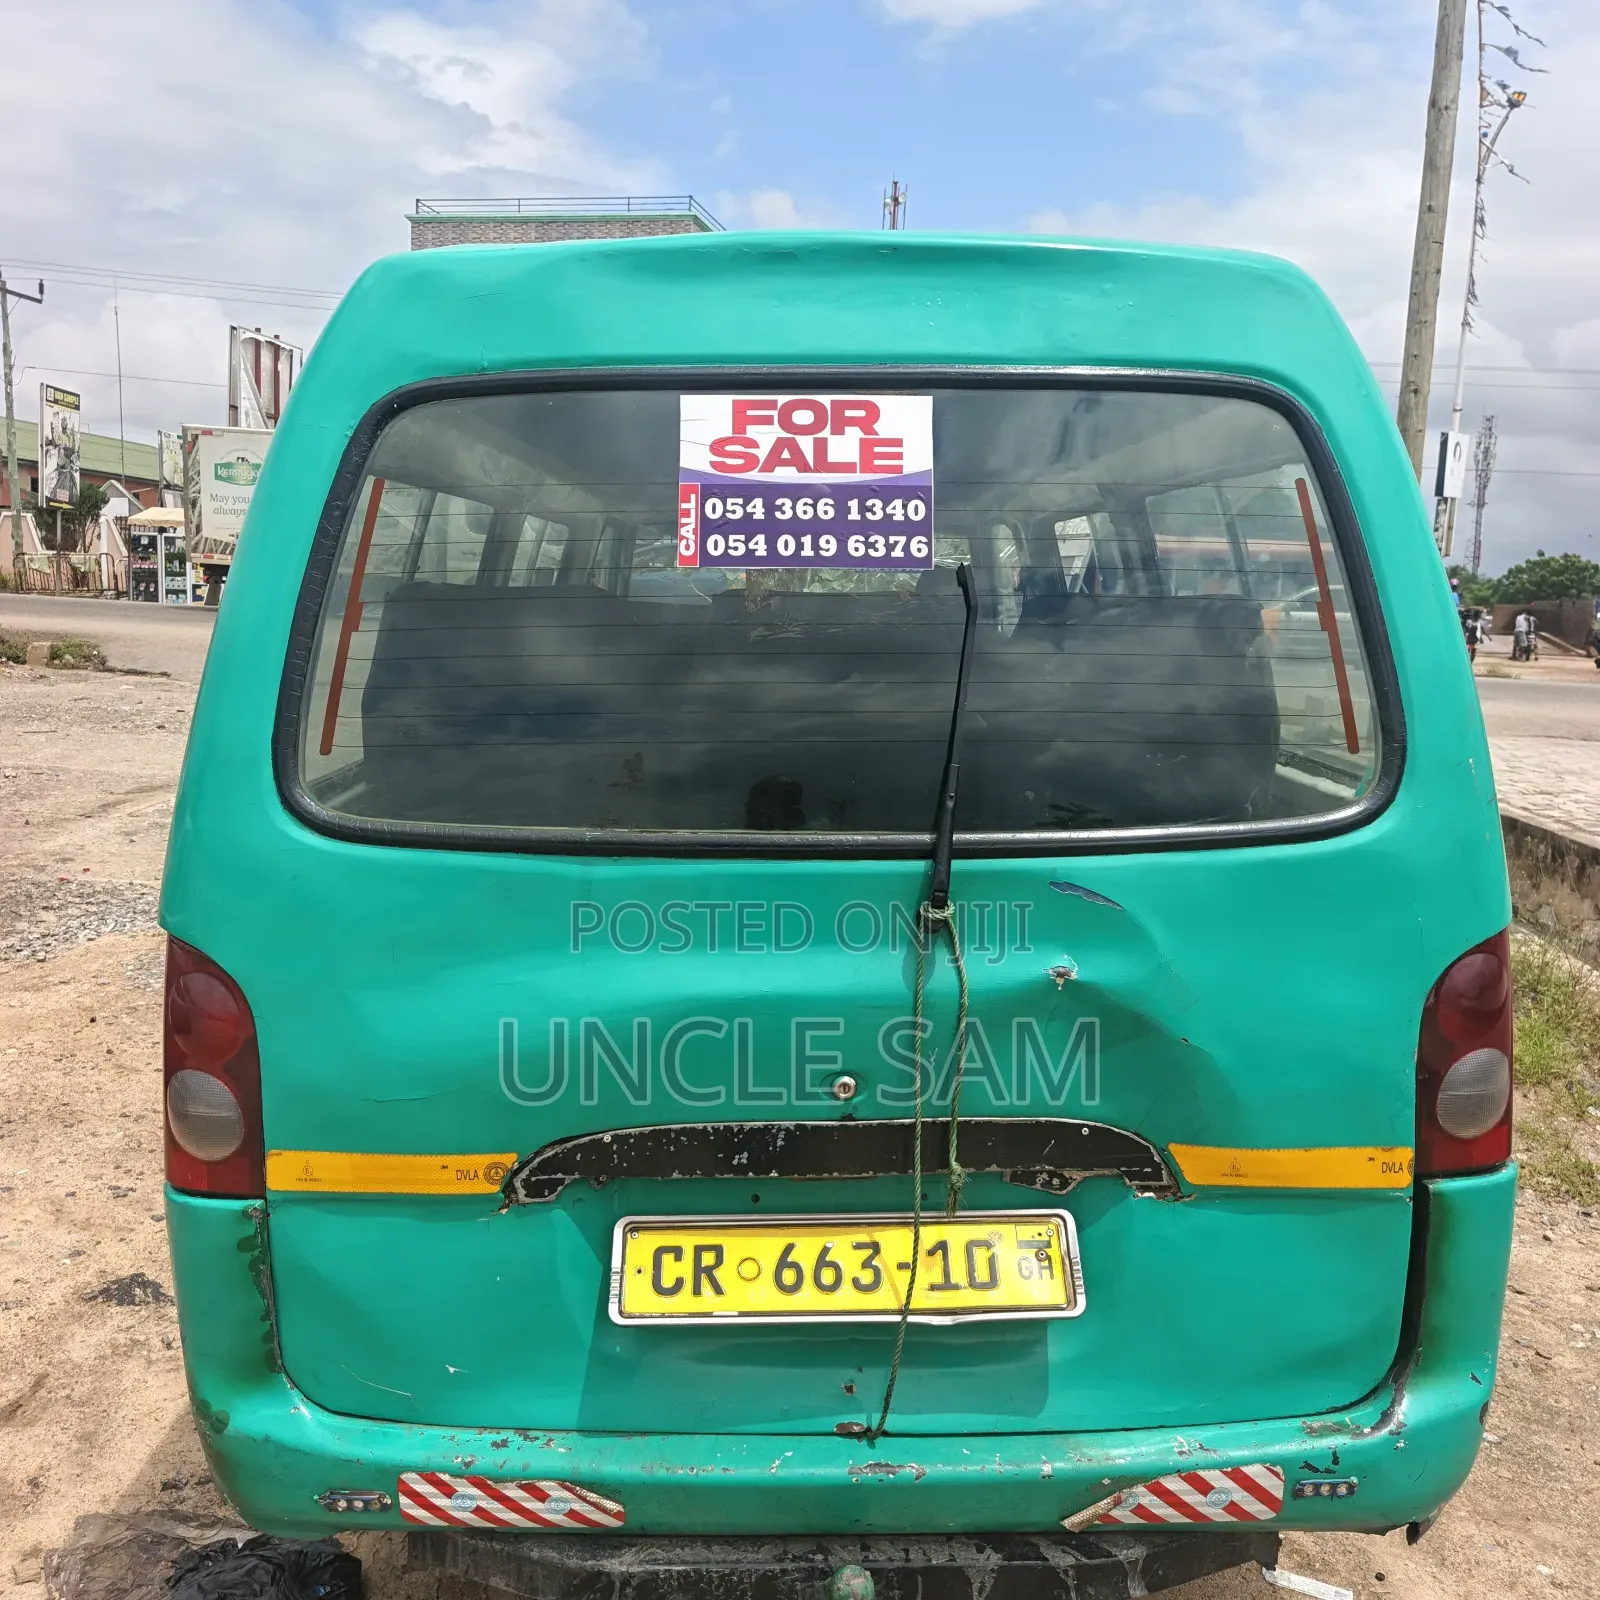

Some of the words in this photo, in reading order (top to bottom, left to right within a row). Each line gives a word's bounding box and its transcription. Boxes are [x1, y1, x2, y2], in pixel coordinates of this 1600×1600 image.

[732, 398, 880, 436] FOR
[709, 436, 903, 474] SALE
[209, 493, 230, 505] May
[232, 495, 250, 505] you
[704, 498, 765, 520] 054
[774, 498, 835, 520] 366
[847, 498, 926, 521] 1340
[213, 505, 247, 518] always
[680, 494, 696, 556] CALL
[706, 534, 767, 556] 054
[777, 534, 837, 557] 019
[847, 535, 929, 558] 6376
[456, 1169, 480, 1181] DVLA
[1381, 1161, 1404, 1174] DVLA
[652, 1243, 725, 1298] CR
[1017, 1254, 1054, 1281] GH
